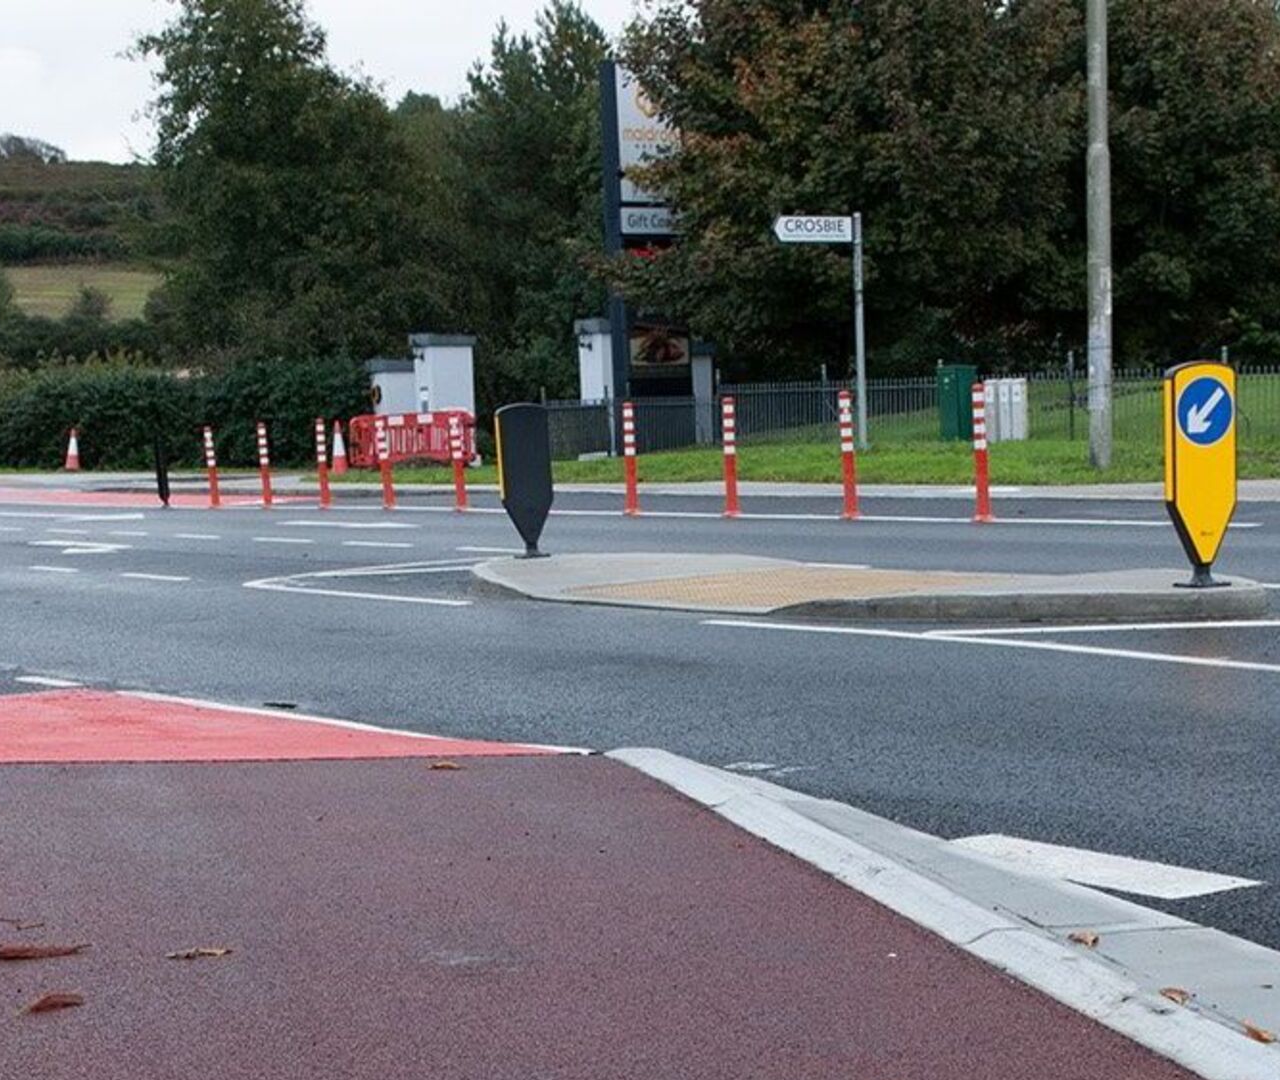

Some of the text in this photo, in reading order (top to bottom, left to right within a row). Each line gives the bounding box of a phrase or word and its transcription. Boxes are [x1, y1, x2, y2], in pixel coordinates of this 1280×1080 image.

[623, 127, 682, 141] maldro
[627, 213, 648, 228] Gift
[784, 219, 845, 233] CROSBIE
